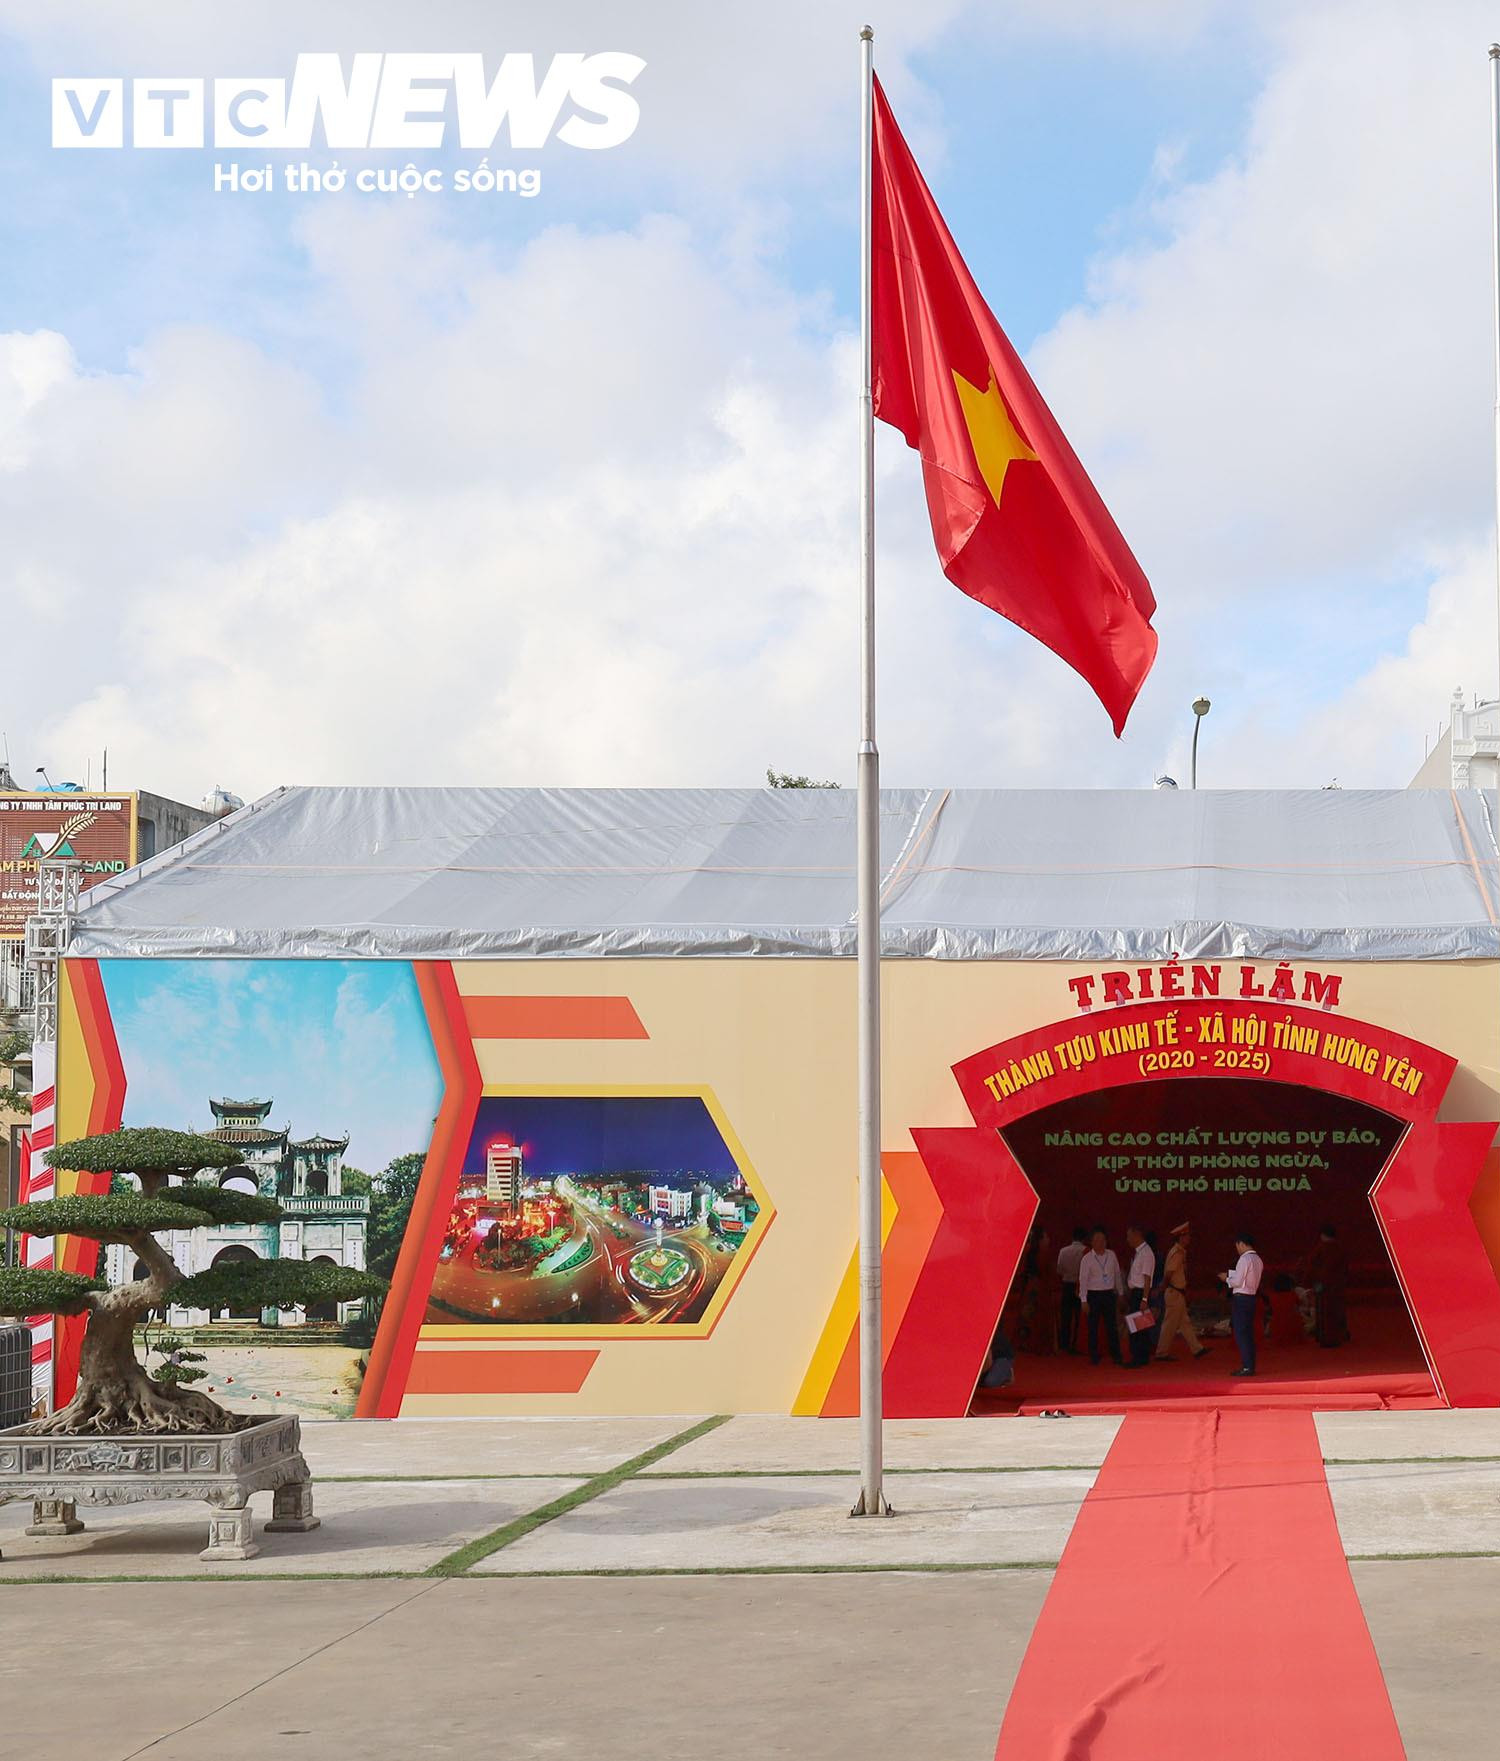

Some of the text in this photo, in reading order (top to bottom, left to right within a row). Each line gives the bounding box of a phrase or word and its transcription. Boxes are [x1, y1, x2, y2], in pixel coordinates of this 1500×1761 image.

[11, 801, 21, 810] TY
[22, 801, 43, 810] TNHH
[63, 800, 85, 810] PHÚC
[100, 801, 122, 810] LAND
[1068, 952, 1343, 1007] TRIỂN LÃM
[984, 1050, 1054, 1102] THÀNH
[1054, 1035, 1096, 1071] TỰU
[1098, 1022, 1149, 1057] KINH
[1154, 1010, 1179, 1046] TẾ
[1198, 1012, 1225, 1043] XÃ
[1231, 1013, 1267, 1050] HỘI
[1273, 1016, 1319, 1055] TỈNH
[1321, 1033, 1379, 1075] HƯNG
[1381, 1053, 1423, 1096] YÊN
[1138, 1050, 1195, 1076] (2020
[1214, 1050, 1271, 1074] 2025)
[1044, 1126, 1381, 1148] NÂNG CAO CHẤT LƯỢNG DỰ BÁO,
[1097, 1151, 1329, 1173] KỊP THỜI PHÒNG NGỪA,
[1115, 1173, 1312, 1195] ỨNG PHÓ HIỆU QUẢ
